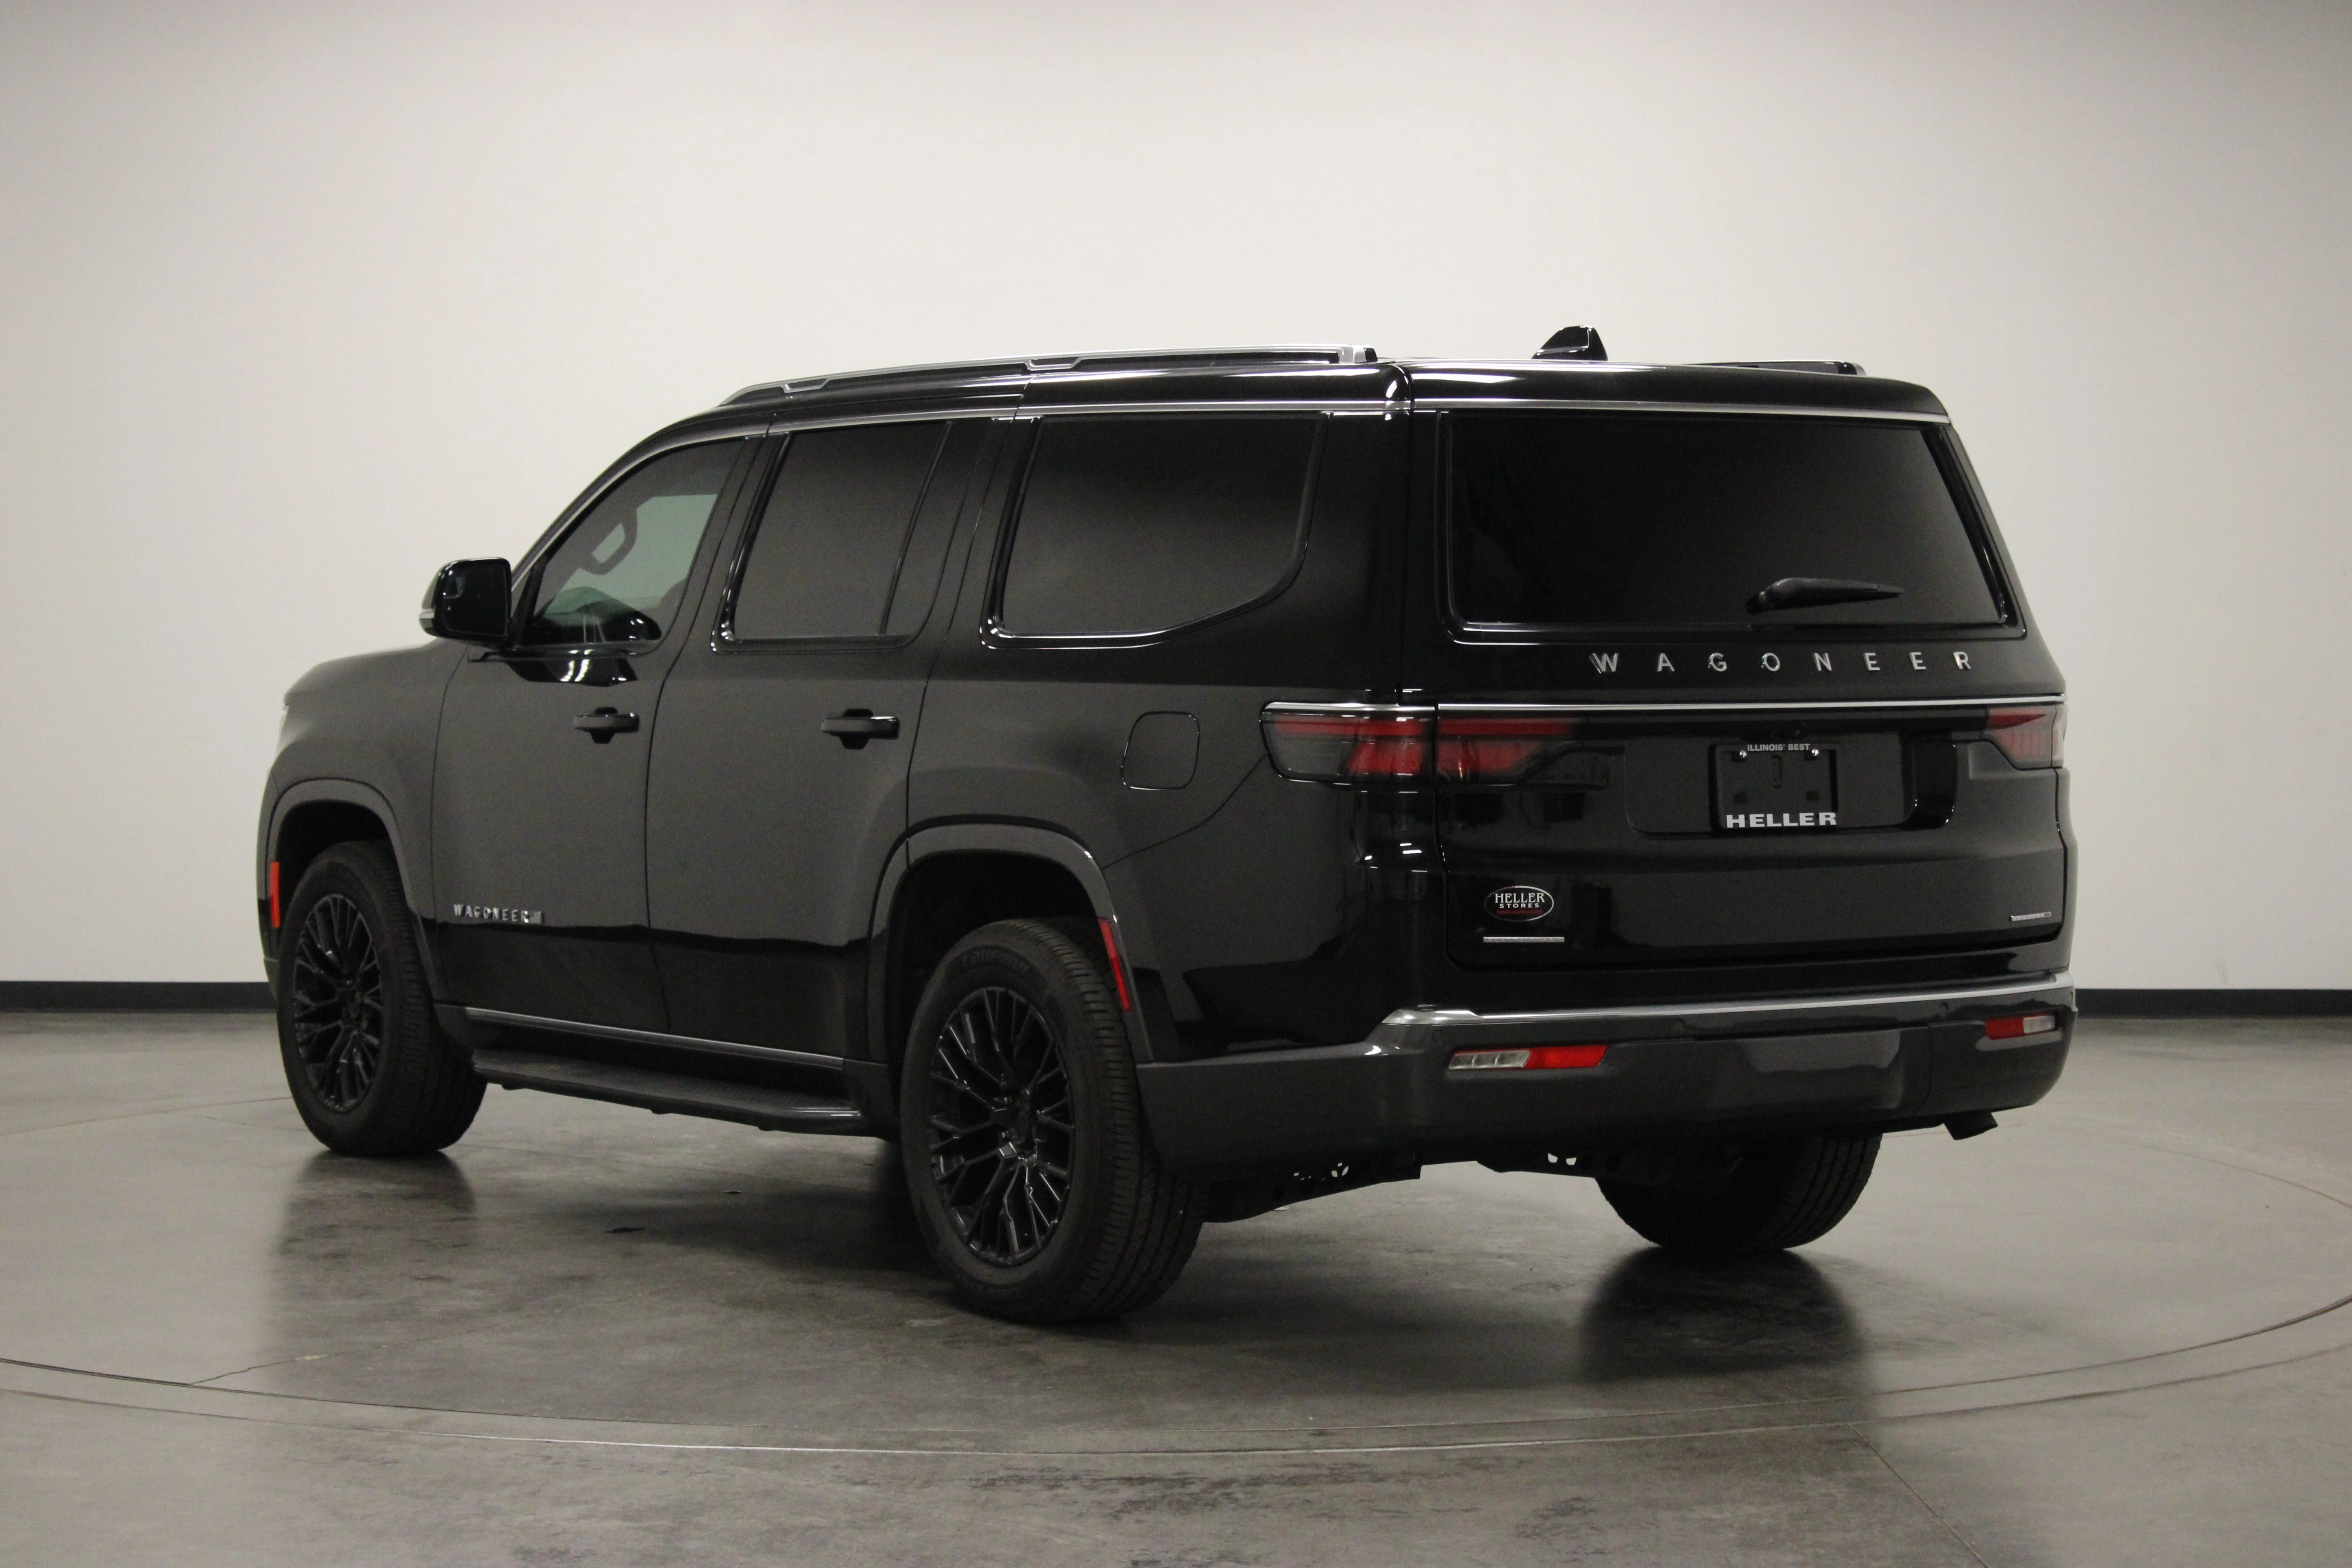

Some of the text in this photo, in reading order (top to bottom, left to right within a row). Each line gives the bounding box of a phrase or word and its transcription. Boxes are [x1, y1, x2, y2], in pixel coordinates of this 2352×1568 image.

[1590, 651, 1971, 674] WAGONEER
[1726, 812, 1837, 828] HELLER
[1495, 893, 1545, 903] HELLER
[454, 904, 530, 923] WAGONEER
